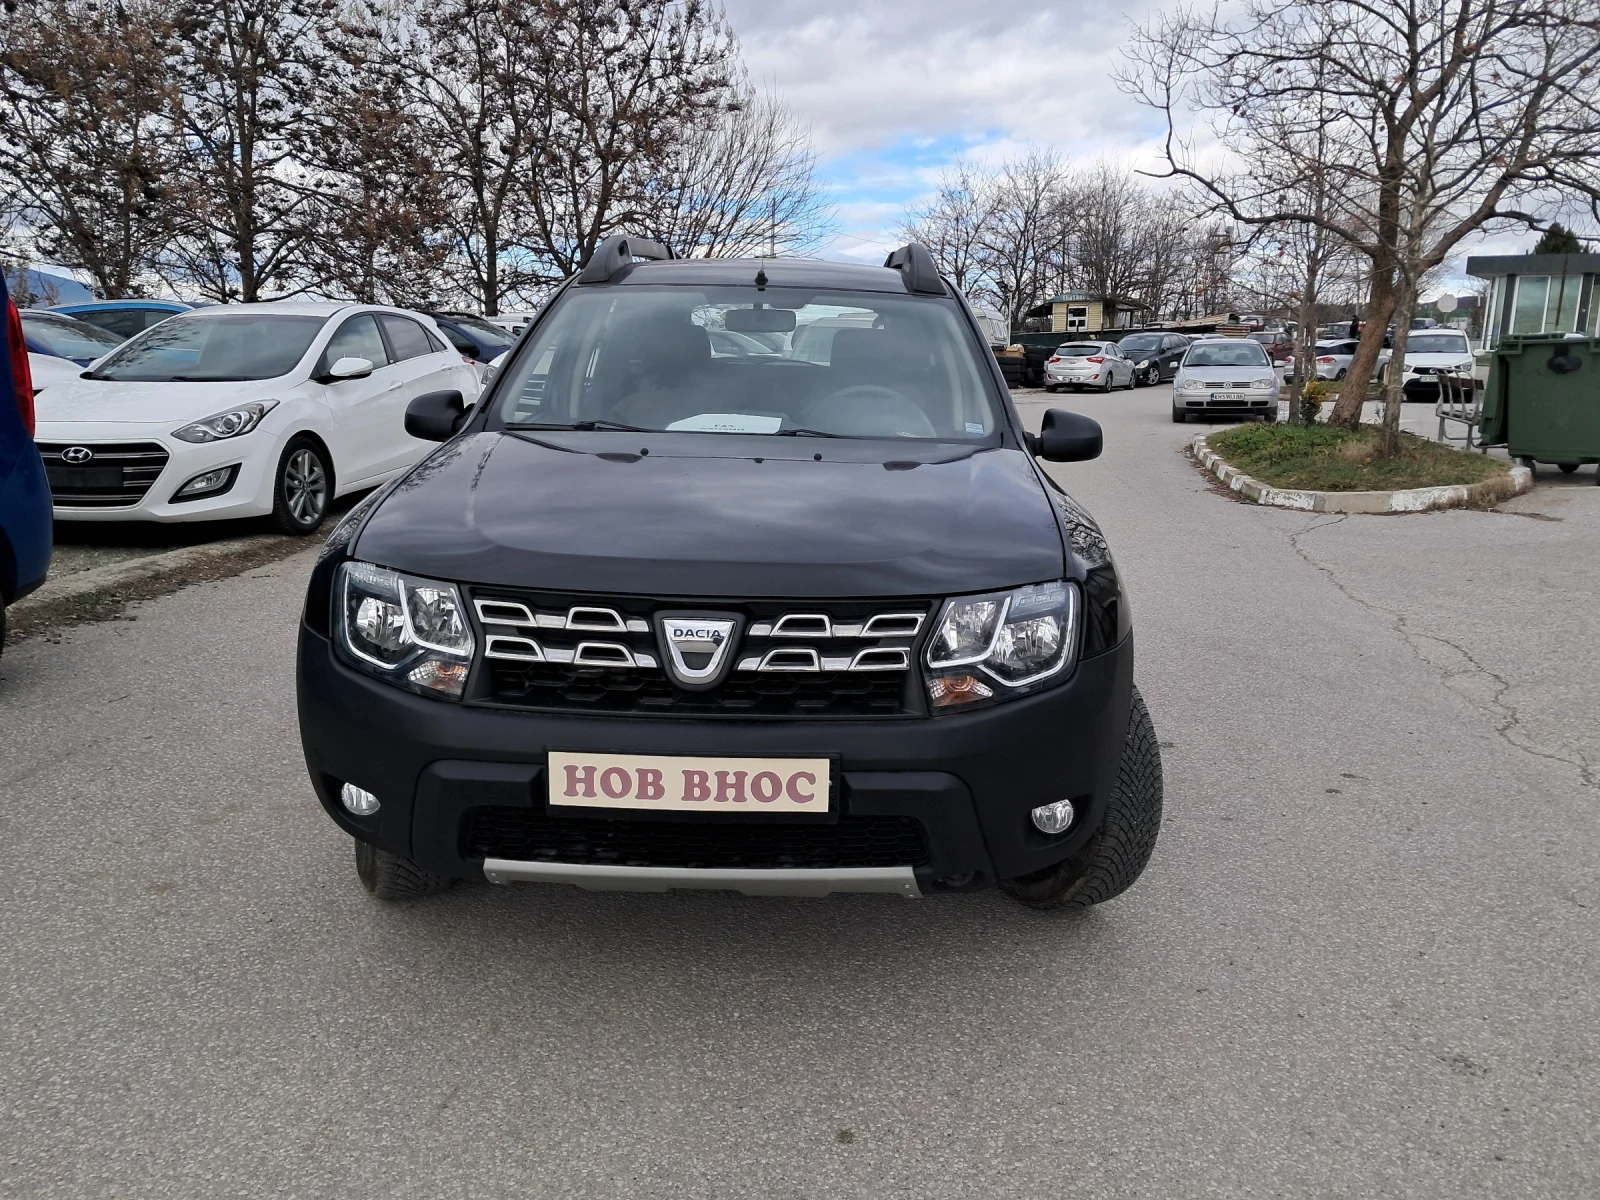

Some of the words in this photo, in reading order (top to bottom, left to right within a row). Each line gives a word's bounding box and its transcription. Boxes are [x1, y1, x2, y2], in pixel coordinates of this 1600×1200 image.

[673, 628, 721, 638] DACIA
[563, 764, 666, 801] НОВ
[680, 769, 817, 804] ВНОС
